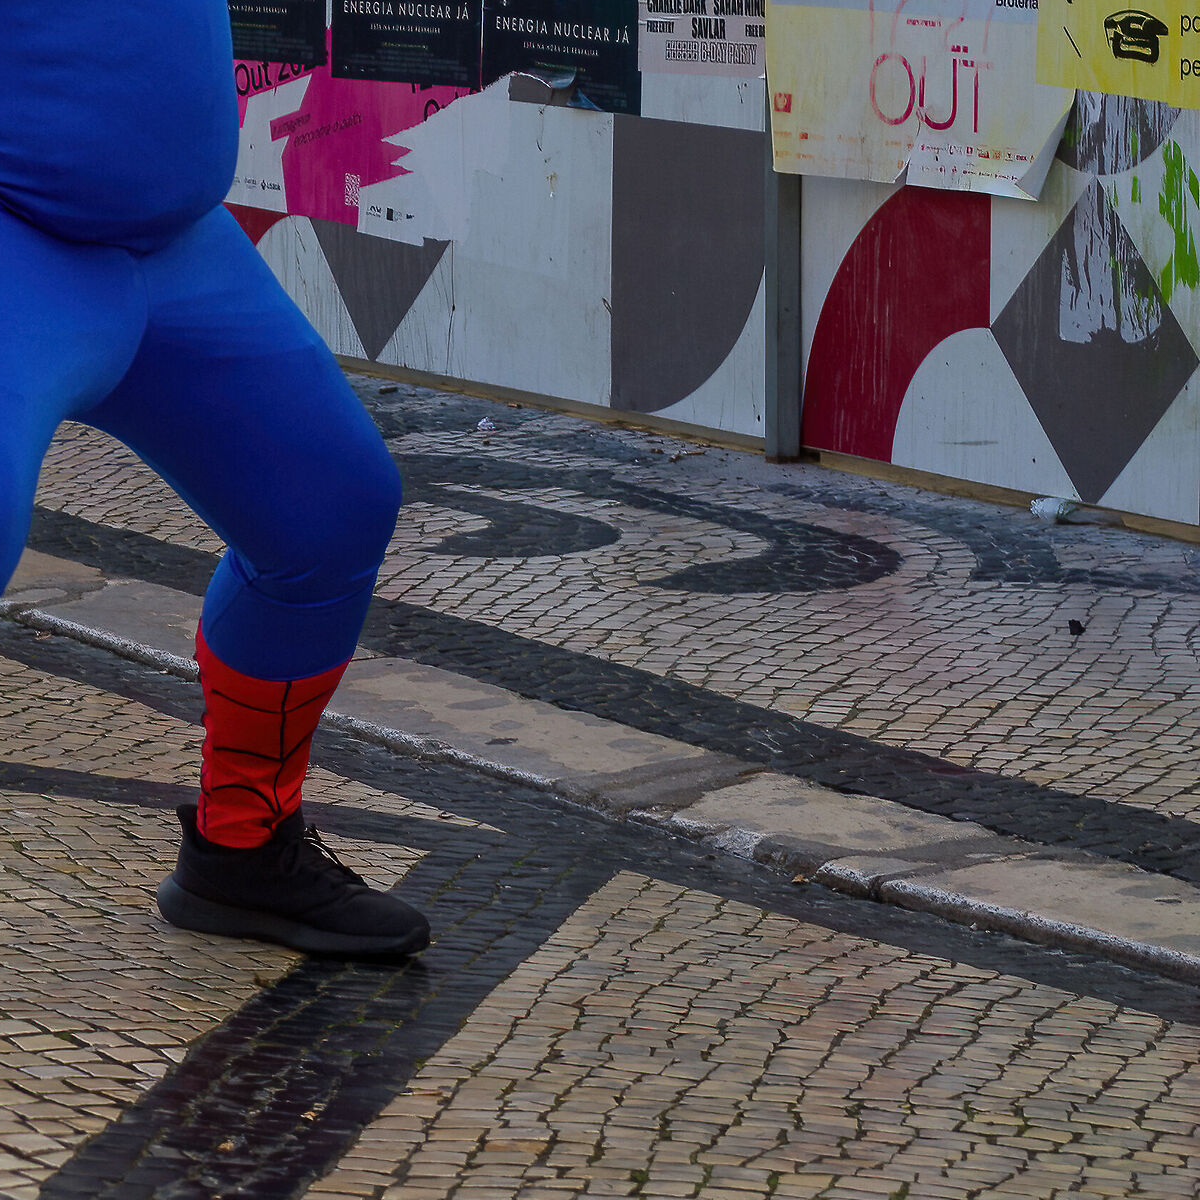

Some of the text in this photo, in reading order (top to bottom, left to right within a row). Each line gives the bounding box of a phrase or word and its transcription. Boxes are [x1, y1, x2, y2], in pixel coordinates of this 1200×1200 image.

[343, 0, 469, 20] ENERGIA NUCLEAR JÁ
[495, 15, 630, 44] ENERGIA NUCLEAR JÁ
[692, 17, 726, 39] SAVLAR
